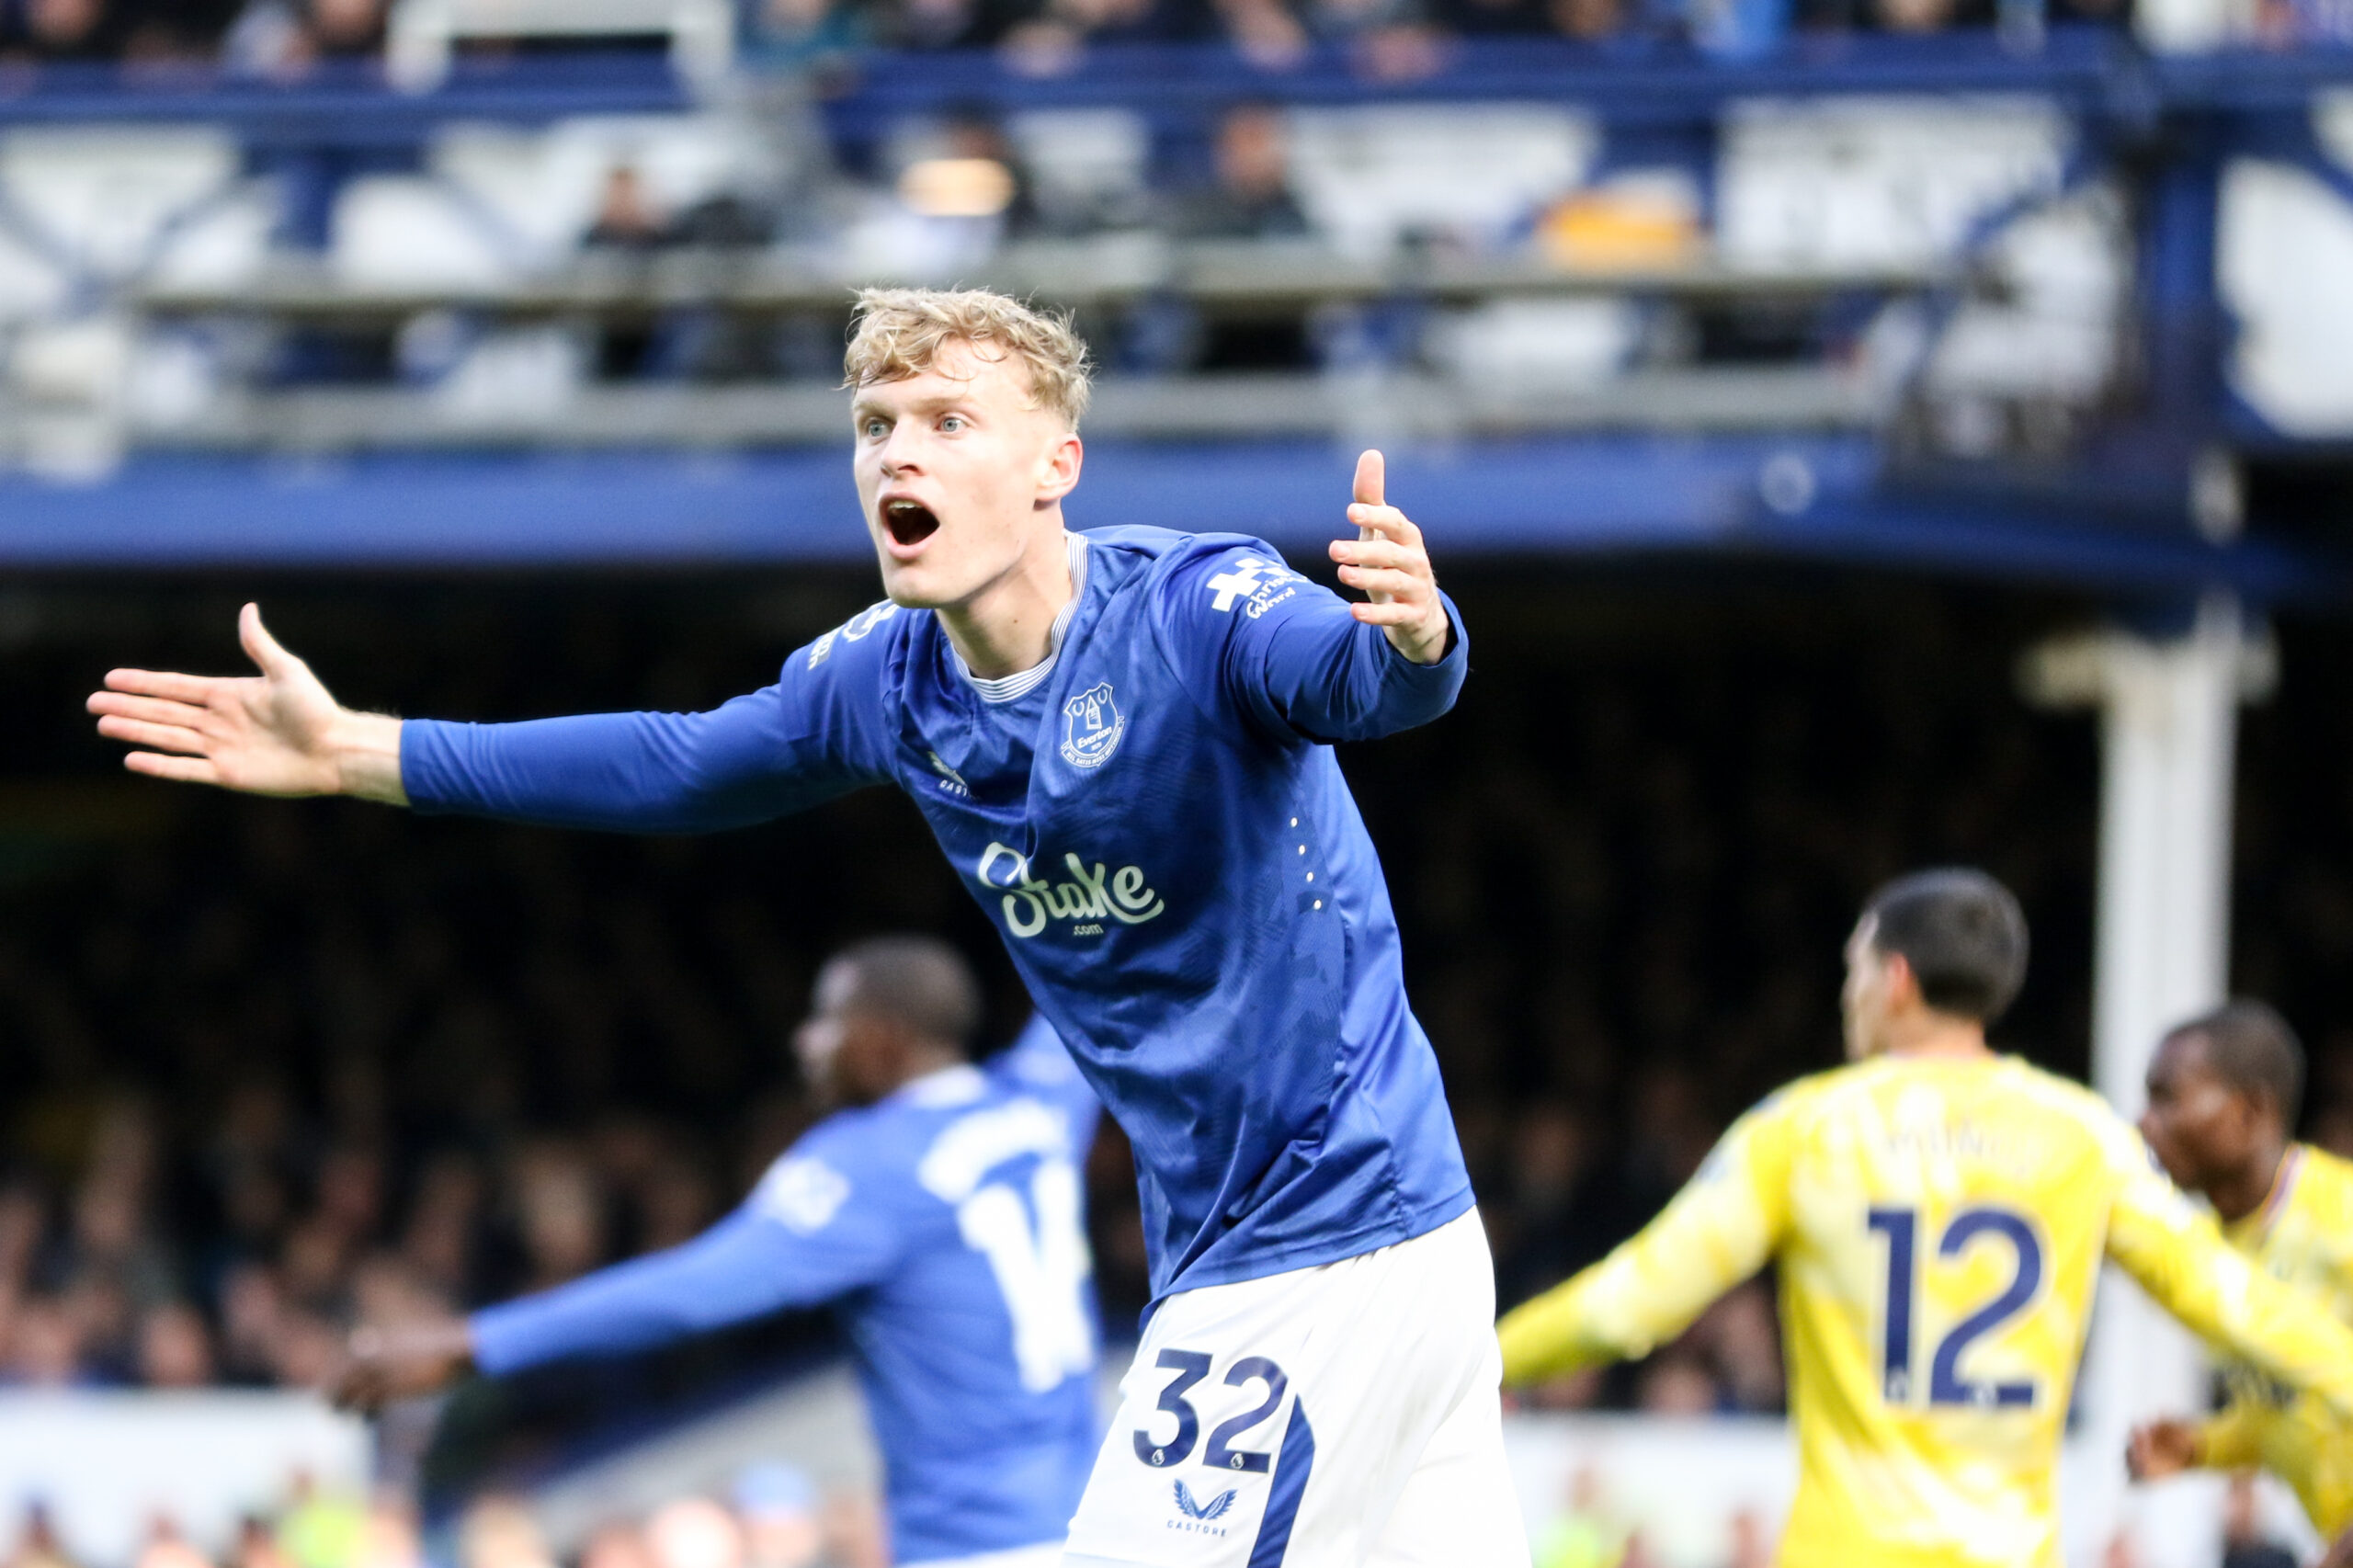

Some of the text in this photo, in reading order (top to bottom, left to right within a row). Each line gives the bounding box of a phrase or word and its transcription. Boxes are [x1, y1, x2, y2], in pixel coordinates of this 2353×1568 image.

[1077, 726, 1112, 748] Everton
[978, 841, 1165, 938] Stake
[1074, 923, 1104, 937] .com
[1867, 1206, 2043, 1406] 12
[1132, 1347, 1289, 1474] 32
[1166, 1519, 1227, 1538] CASTORE
